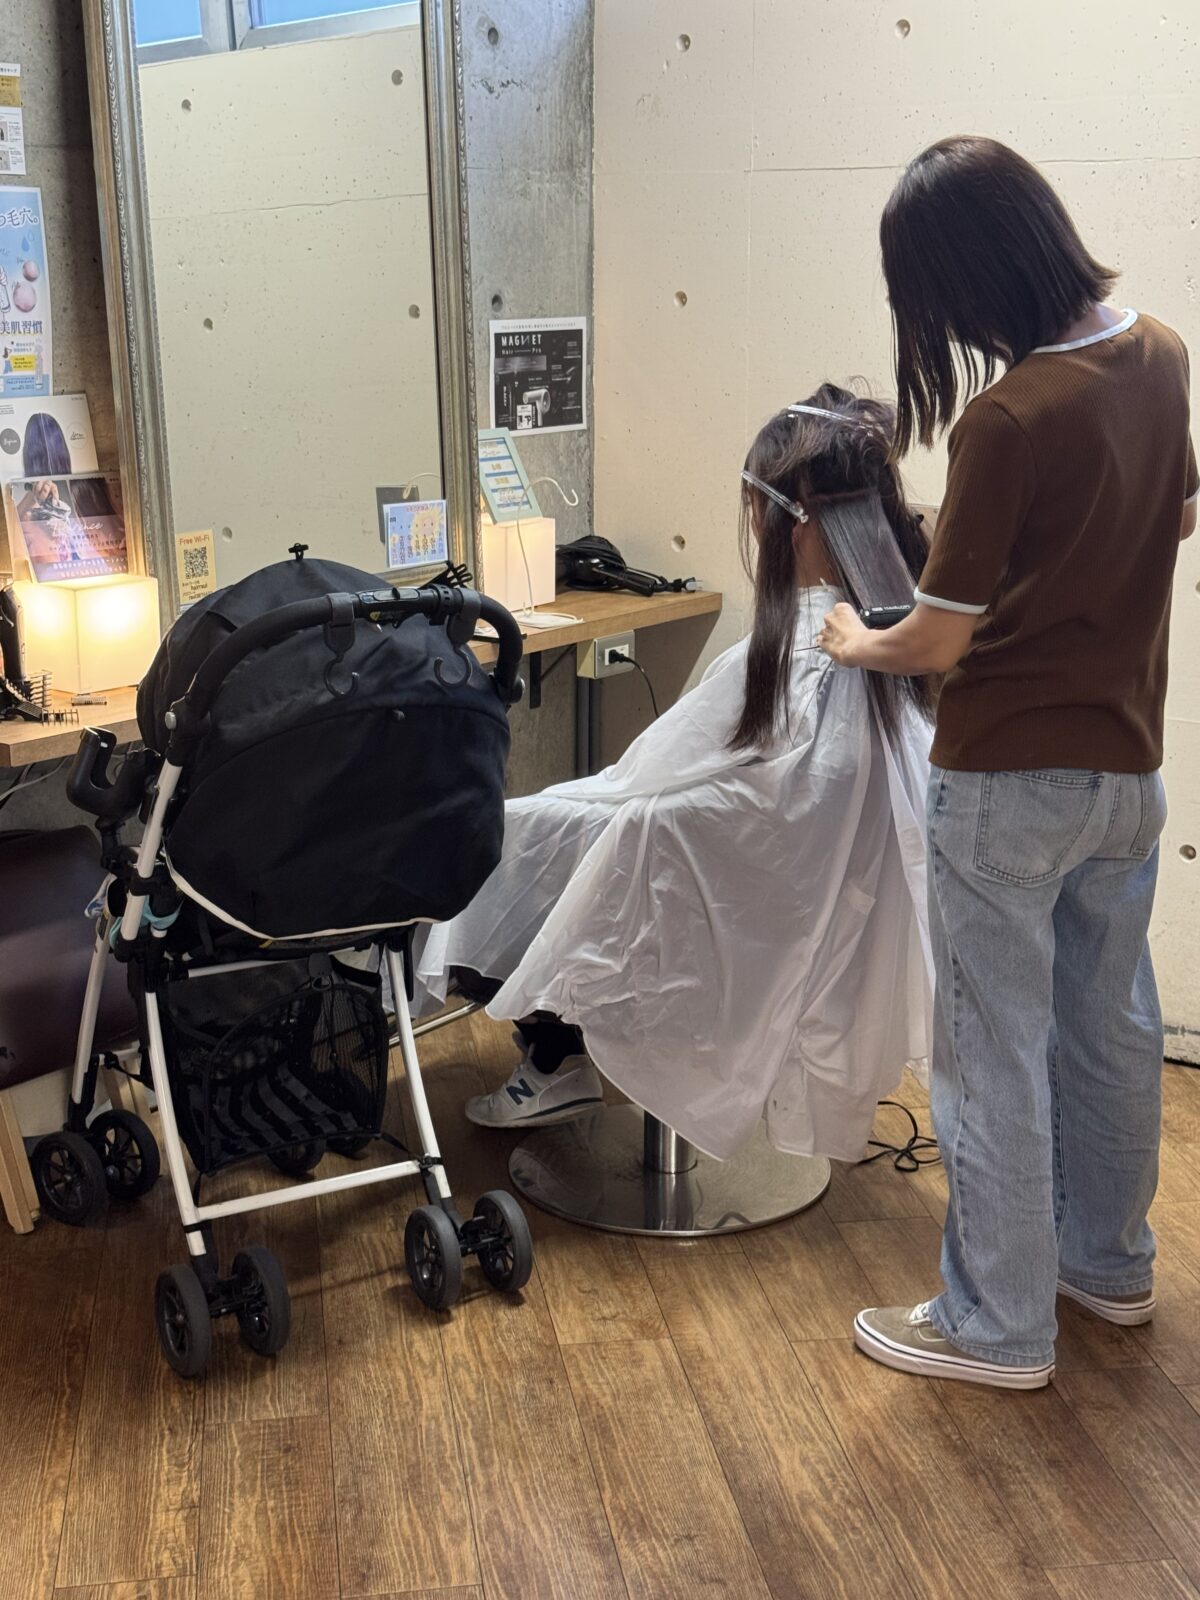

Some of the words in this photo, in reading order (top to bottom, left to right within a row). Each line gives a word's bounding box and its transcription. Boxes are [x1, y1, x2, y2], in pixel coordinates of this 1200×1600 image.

[501, 335, 542, 347] MAGNET
[180, 538, 193, 546] Free
[506, 1078, 535, 1105] N
